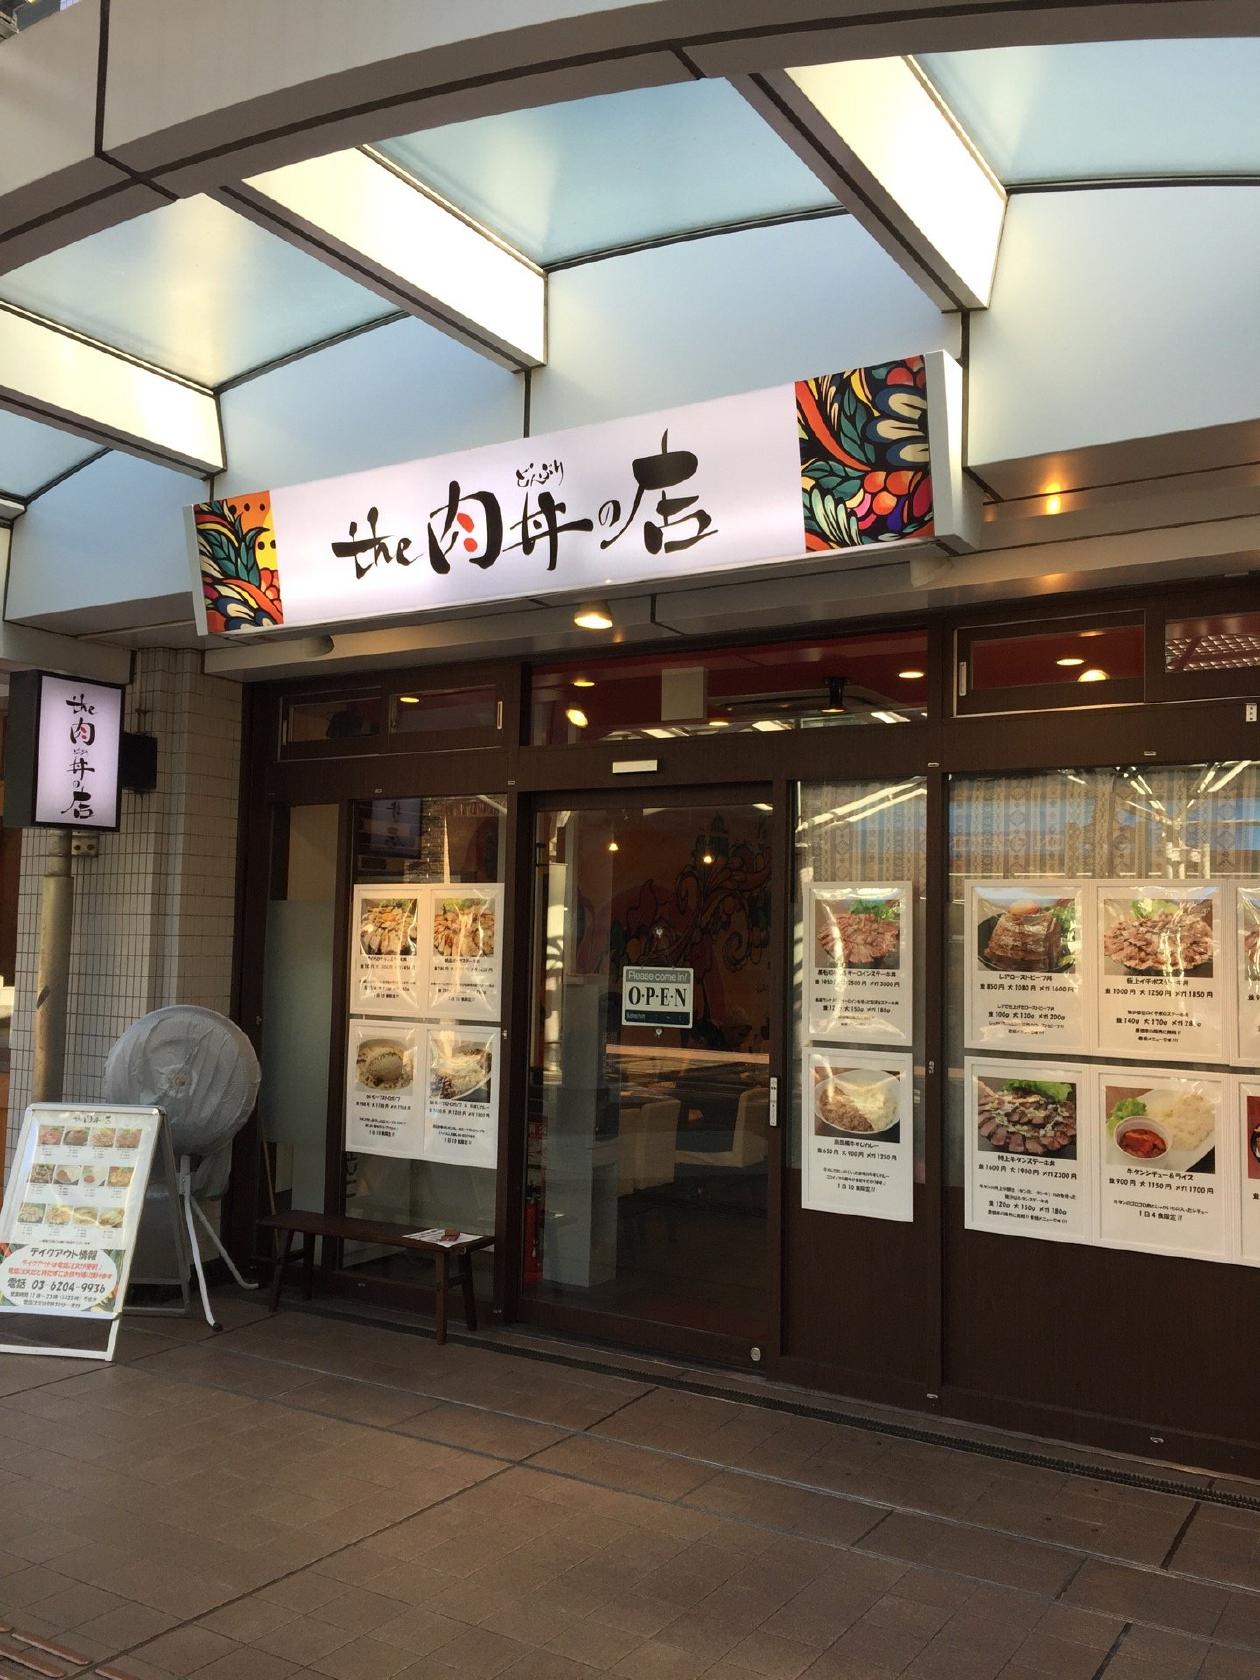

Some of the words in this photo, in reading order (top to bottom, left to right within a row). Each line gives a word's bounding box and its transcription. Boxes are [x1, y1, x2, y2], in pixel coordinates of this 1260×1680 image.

[515, 460, 565, 488] どんぶり
[330, 506, 424, 580] the
[425, 429, 719, 575] 肉丼の店
[66, 693, 99, 716] the
[628, 970, 654, 980] Please
[654, 972, 677, 981] come
[30, 1247, 98, 1260] テイクアウト情報
[8, 1278, 26, 1289] 電話
[31, 1280, 45, 1290] 03
